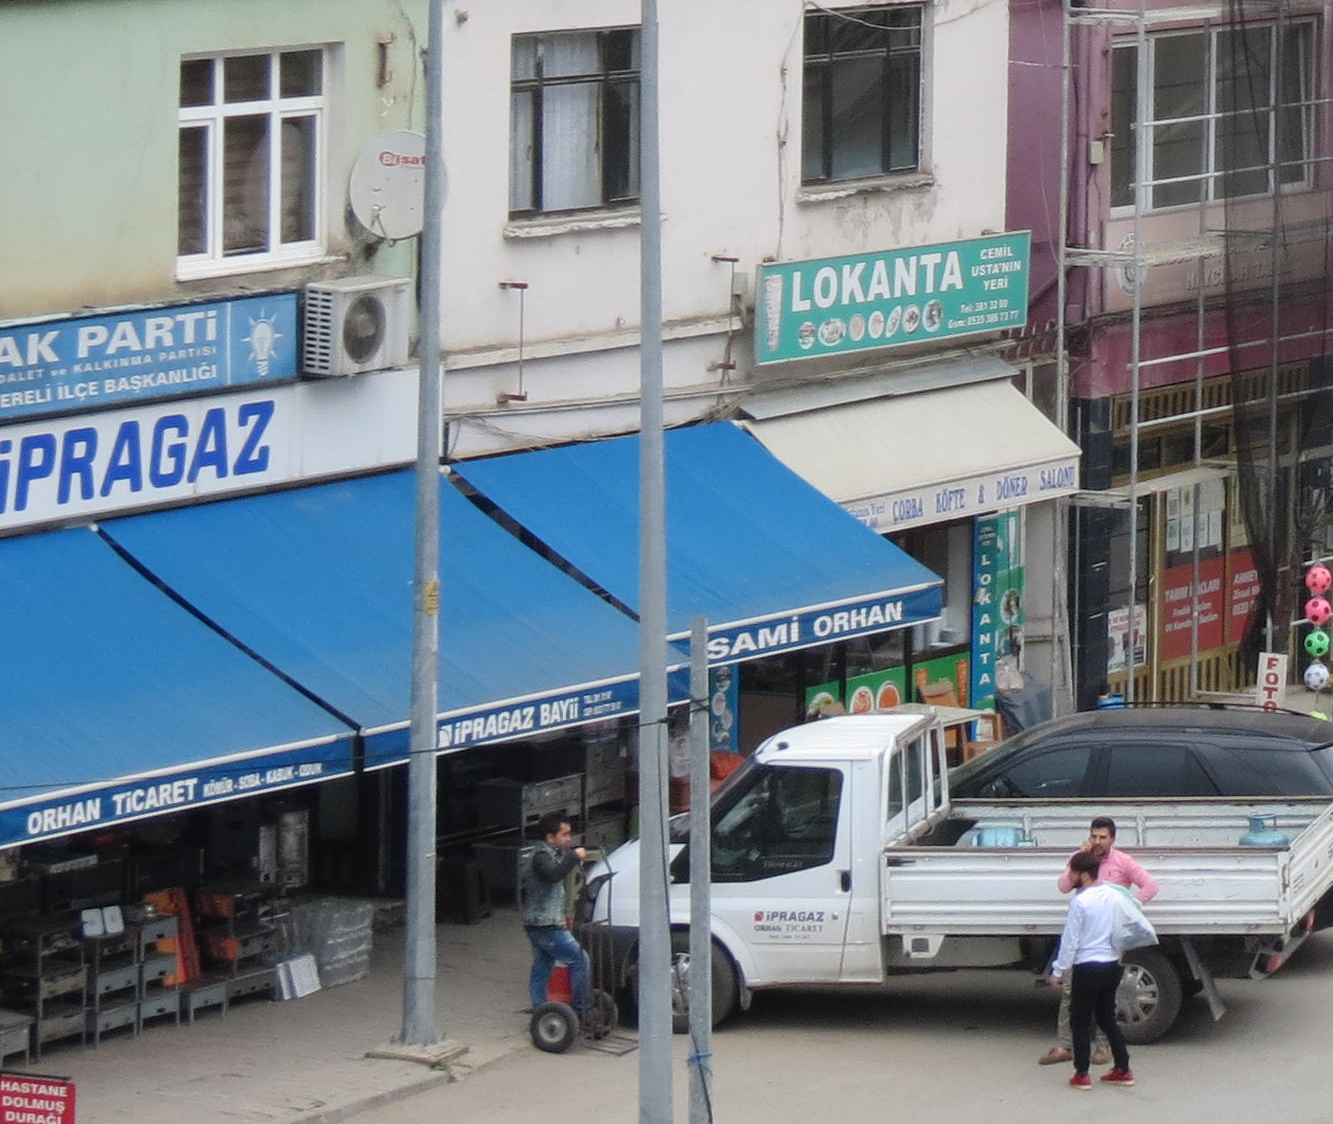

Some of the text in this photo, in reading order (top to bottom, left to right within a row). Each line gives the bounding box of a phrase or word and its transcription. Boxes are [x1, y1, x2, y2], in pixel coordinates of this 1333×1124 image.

[981, 244, 1013, 259] CEMİL
[791, 251, 963, 313] LOKANTA
[983, 275, 1008, 290] YERİ
[0, 330, 60, 368] AK
[74, 354, 152, 374] KALKINMA
[57, 381, 98, 402] İLÇE
[105, 363, 217, 393] BAŞKANLIĞI
[935, 487, 965, 514] KÖFTE
[978, 484, 985, 504] &
[996, 475, 1028, 501] DÖNER
[1040, 466, 1075, 491] SALONU
[708, 601, 903, 659] SAMİ ORHAN
[979, 553, 992, 685] LOKANTA
[27, 778, 198, 835] ORHAN TİCARET
[0, 1080, 68, 1097] HASTANE
[2, 1096, 66, 1115] DOLMUŞ
[5, 1110, 62, 1124] DURAĞI
